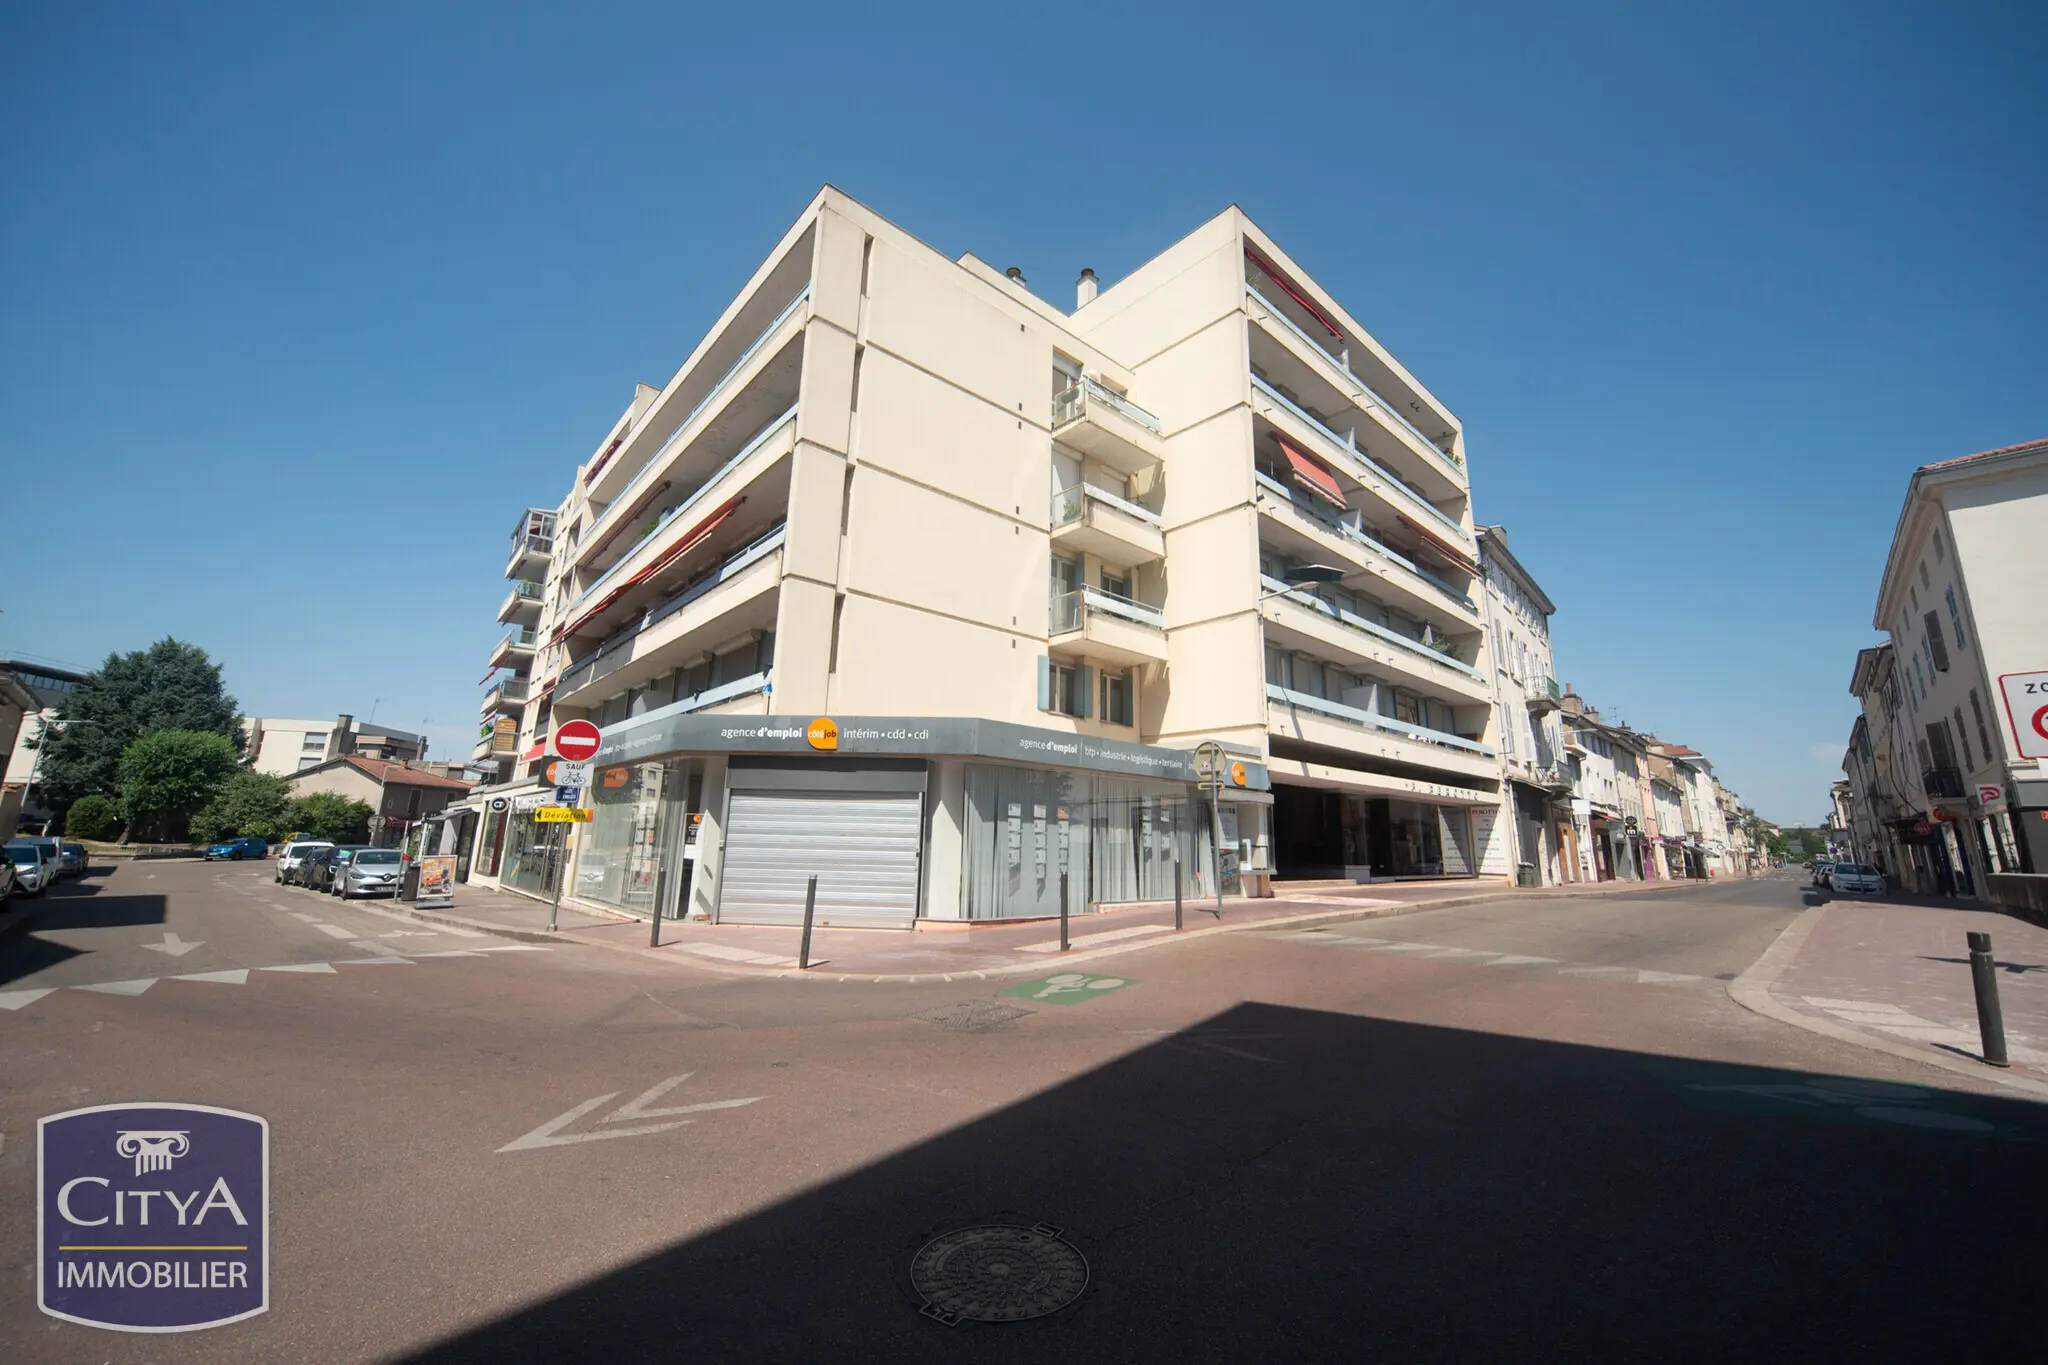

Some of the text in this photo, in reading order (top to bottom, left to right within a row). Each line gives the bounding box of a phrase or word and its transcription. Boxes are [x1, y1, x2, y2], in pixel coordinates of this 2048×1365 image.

[721, 727, 803, 740] agence d'emploi
[843, 728, 929, 739] intérim cdd cdi
[1019, 739, 1046, 750] agence
[1046, 741, 1078, 755] d'emploi
[1100, 749, 1127, 761] industrie
[1131, 754, 1158, 767] logistique
[565, 763, 586, 771] SAUF
